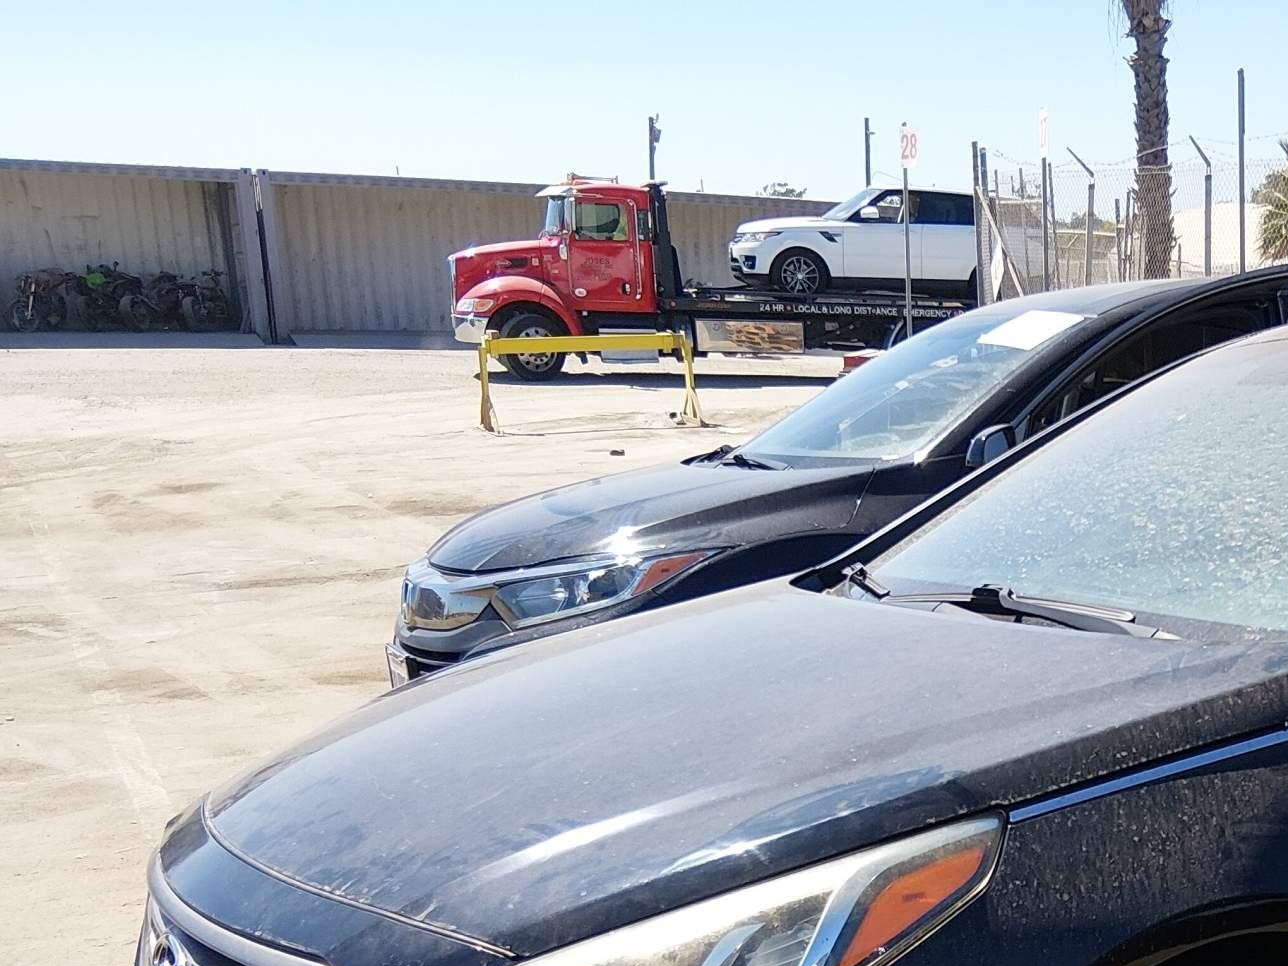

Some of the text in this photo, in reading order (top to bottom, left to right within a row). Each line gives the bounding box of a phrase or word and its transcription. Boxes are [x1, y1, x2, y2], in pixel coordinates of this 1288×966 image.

[900, 133, 918, 160] 28
[759, 303, 770, 312] 24
[772, 304, 785, 312] HR
[792, 304, 821, 314] LOCAL
[829, 304, 852, 315] LONG
